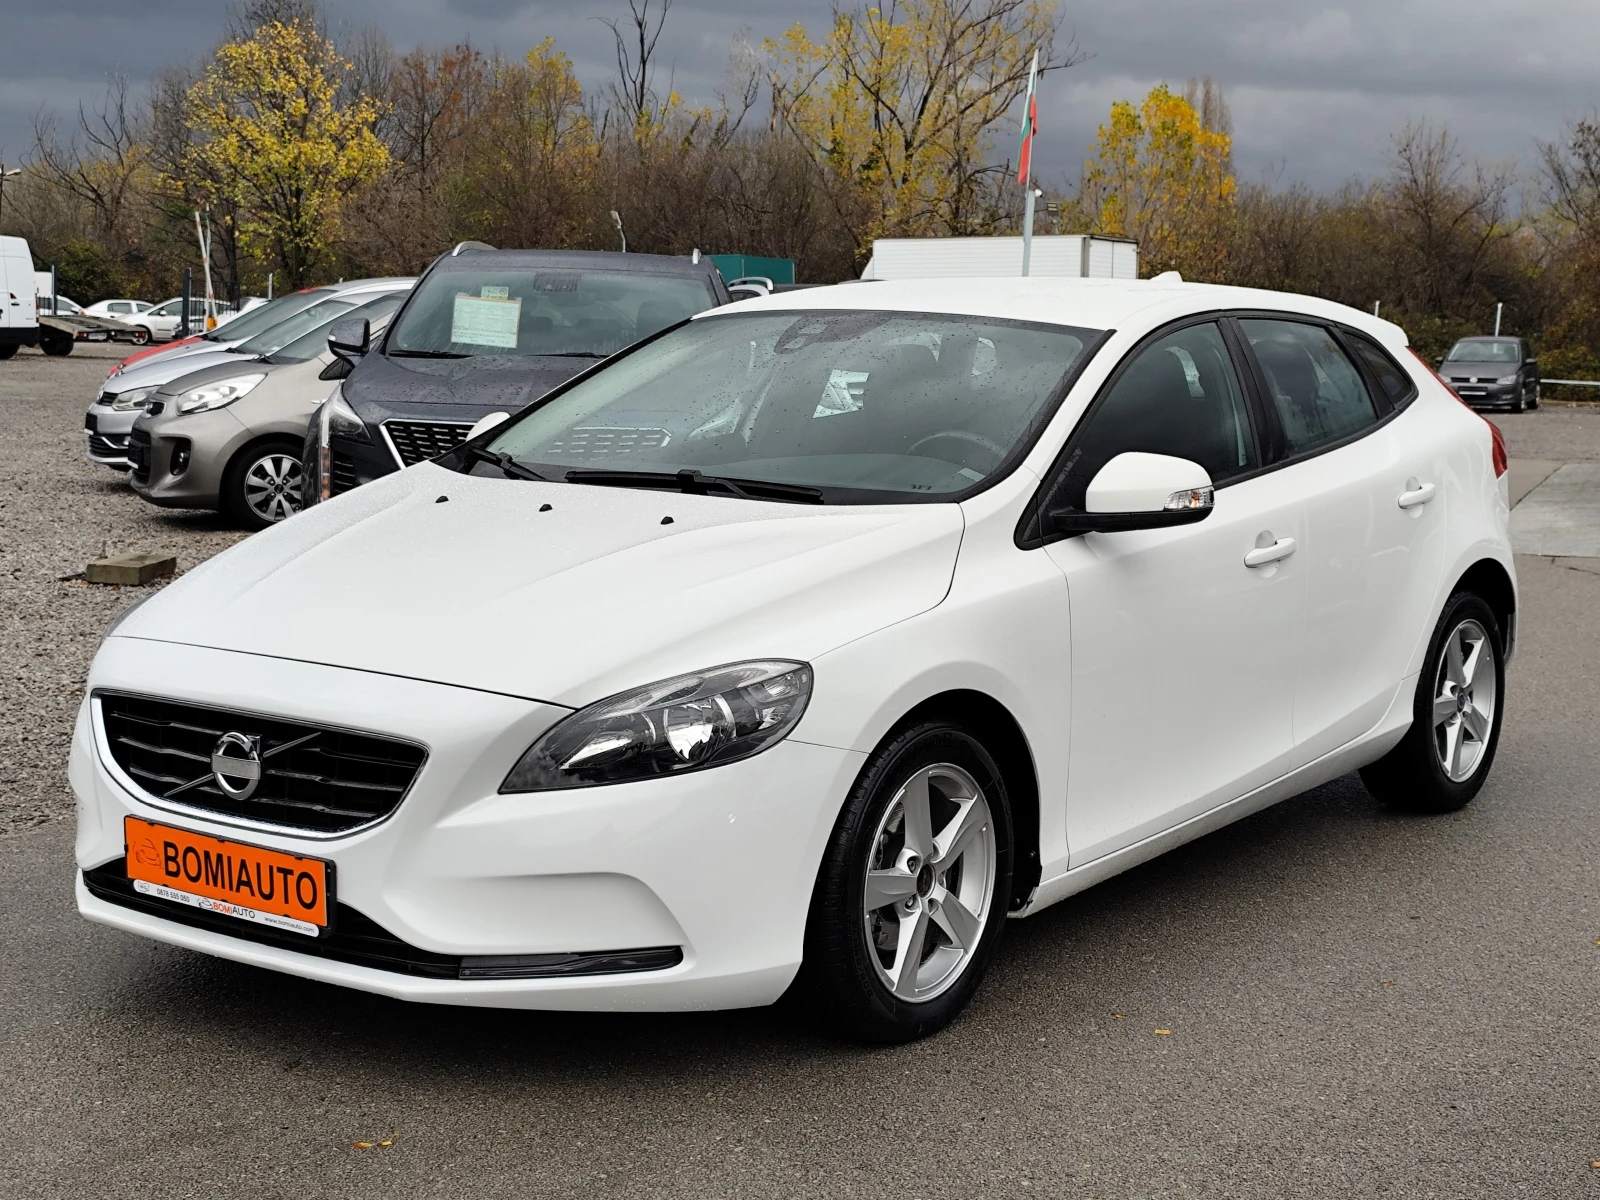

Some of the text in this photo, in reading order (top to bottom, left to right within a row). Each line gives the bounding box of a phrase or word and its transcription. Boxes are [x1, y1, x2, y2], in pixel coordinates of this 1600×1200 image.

[163, 841, 317, 910] BOMIAUTO
[157, 888, 169, 897] 0878
[170, 892, 180, 900] 555
[213, 902, 255, 919] BOMIAUTO
[264, 917, 315, 933] www.bomiauto.com
